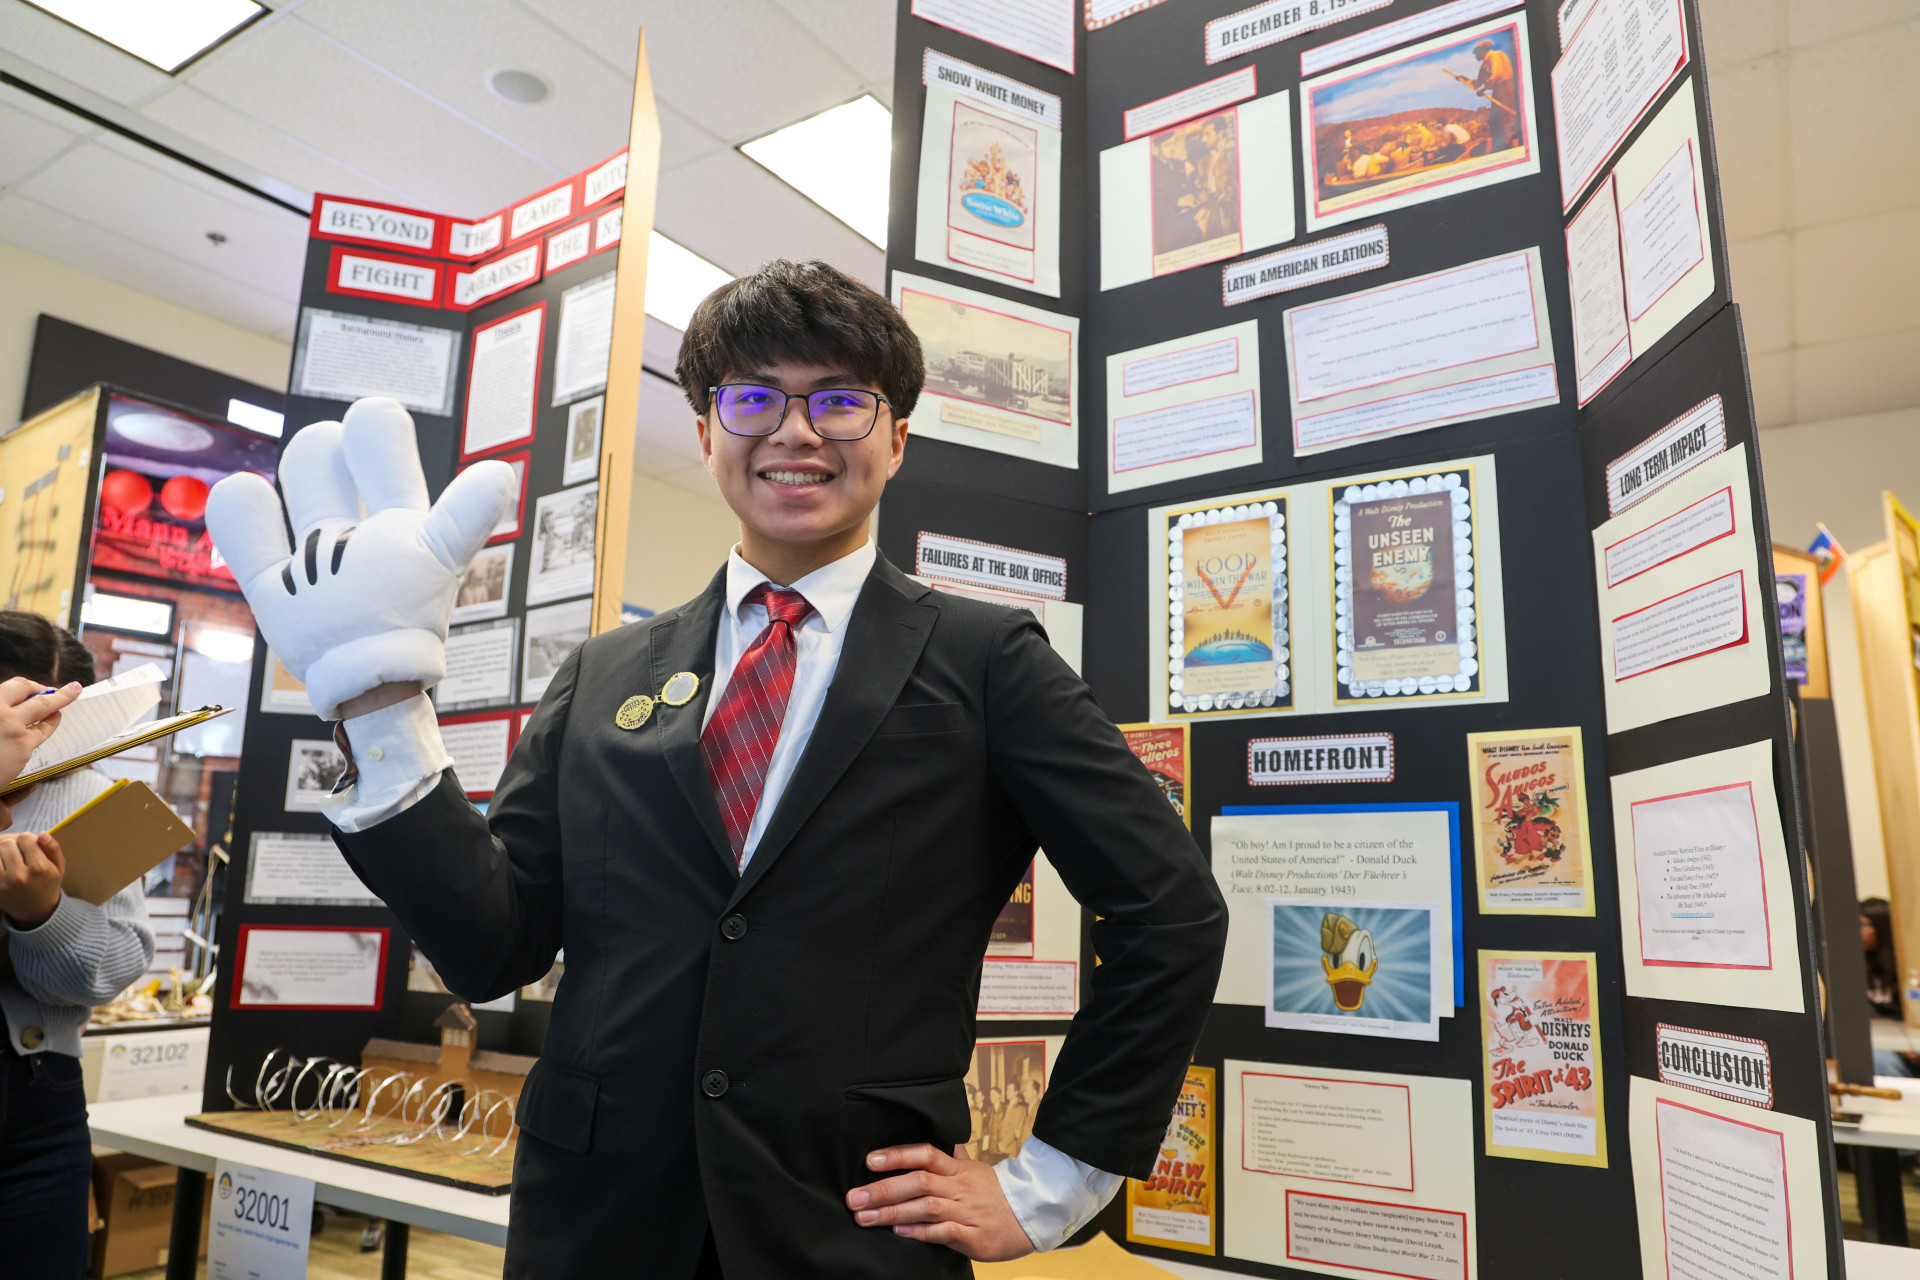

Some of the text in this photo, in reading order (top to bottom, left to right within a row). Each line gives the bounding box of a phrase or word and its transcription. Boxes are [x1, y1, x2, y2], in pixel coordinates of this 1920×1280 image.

[1222, 6, 1300, 47] DECEMBER
[1310, 0, 1325, 15] 8,
[938, 66, 1045, 116] SNOW WHITE MONEY
[966, 196, 1020, 222] Snow White
[331, 211, 429, 242] BEYOND
[460, 228, 496, 249] THE
[516, 196, 566, 229] CAMP:
[351, 238, 582, 297] FIGHT AGAINST THE
[1227, 273, 1256, 293] LATIN
[1260, 257, 1318, 284] AMERICAN
[1322, 239, 1384, 267] RELATIONS
[1619, 423, 1707, 497] LONG TERM IMPACT
[1364, 507, 1379, 515] Walt
[1381, 504, 1404, 514] Disney
[1405, 500, 1443, 510] Production
[102, 504, 189, 547] Mann
[1388, 514, 1413, 528] The
[1368, 527, 1434, 550] UNSEEN
[922, 547, 1063, 587] FAILURES AT THE BOX OFFICE
[1197, 552, 1257, 576] FOOD
[1372, 546, 1431, 568] ENEMY
[1187, 571, 1267, 589] WILL WIN THE WAR
[1141, 740, 1172, 754] Three
[1253, 746, 1387, 773] HOMEFRONT
[1485, 761, 1547, 809] SALUDOS
[1494, 773, 1556, 825] AMIGOS
[1231, 840, 1248, 849] “Oh
[1250, 840, 1269, 851] boy!
[1272, 840, 1287, 849] Am
[1289, 840, 1293, 849] I
[1295, 840, 1320, 851] proud
[1322, 841, 1331, 849] to
[1334, 840, 1345, 849] be
[1354, 840, 1385, 849] citizen
[1387, 840, 1397, 848] of
[1399, 840, 1414, 849] the
[1231, 855, 1259, 864] United
[1261, 855, 1286, 864] States
[1288, 855, 1299, 864] of
[1300, 855, 1345, 864] America!”
[1356, 855, 1390, 864] Donald
[1392, 855, 1418, 864] Duck
[1231, 870, 1253, 880] (Walt
[1255, 870, 1284, 881] Disney
[1343, 870, 1360, 880] Der
[1231, 885, 1356, 896] Face, 8:02-12, January 1943)
[1533, 997, 1581, 1011] Extra Added
[1541, 1002, 1586, 1017] Attraction!
[130, 1043, 189, 1065] 32102
[1548, 1041, 1589, 1051] DONALD
[1554, 1051, 1585, 1061] DUCK
[1492, 1058, 1525, 1080] The
[1661, 1041, 1766, 1090] CONCLUSION
[1179, 1093, 1195, 1101] ALT
[1491, 1069, 1553, 1109] SPIRIT
[1553, 1068, 1564, 1083] of
[1536, 1099, 1581, 1110] Technicolor
[1177, 1131, 1200, 1151] DUCK
[1179, 1124, 1206, 1146] DONALD
[1157, 1159, 1206, 1180] NEW
[1143, 1175, 1206, 1198] SPIRIT
[234, 1187, 289, 1232] 32001
[1350, 1207, 1369, 1215] million
[1426, 1217, 1439, 1225] their
[1344, 1218, 1362, 1227] paying
